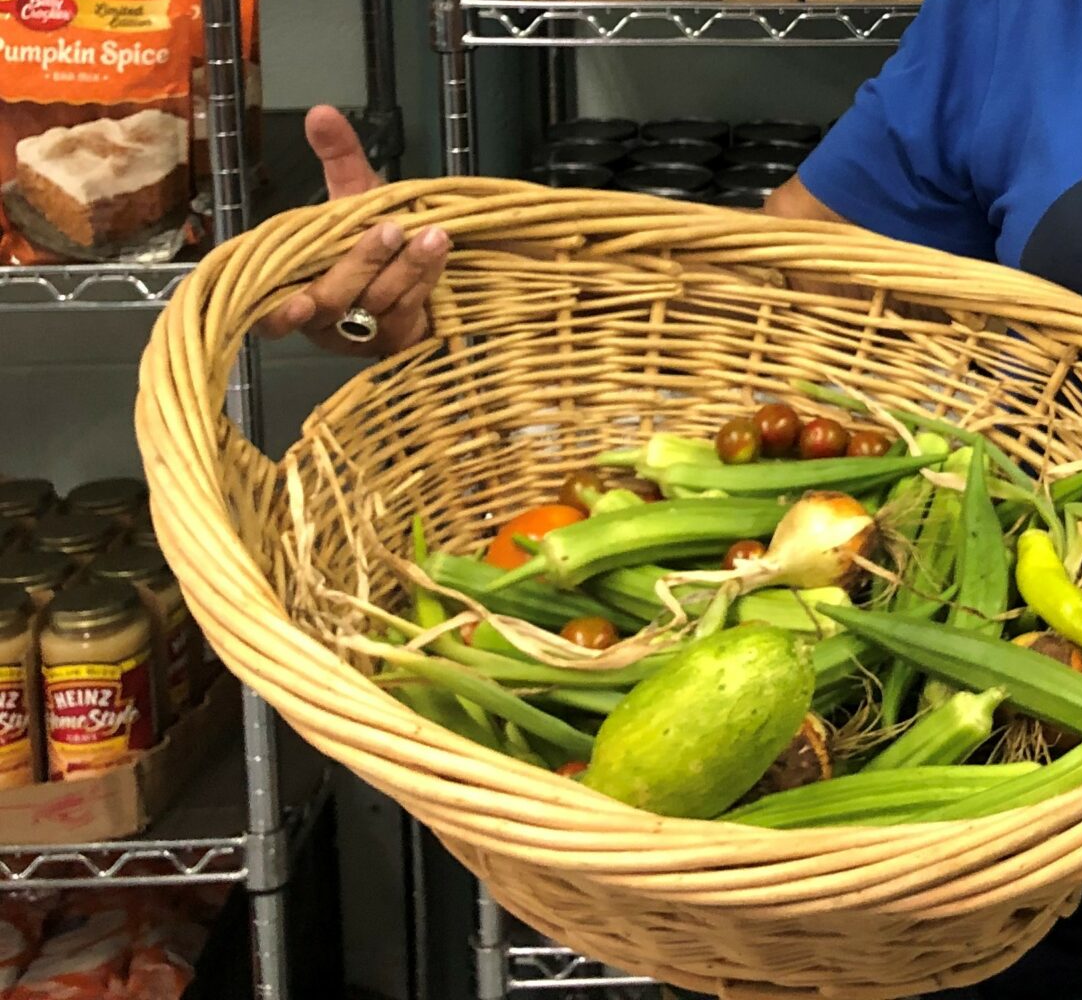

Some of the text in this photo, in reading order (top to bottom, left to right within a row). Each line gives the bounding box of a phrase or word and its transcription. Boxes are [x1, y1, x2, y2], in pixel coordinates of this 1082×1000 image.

[94, 2, 145, 16] Limited
[109, 14, 153, 29] Edition
[100, 39, 170, 73] Spice
[53, 688, 113, 710] HEINZ
